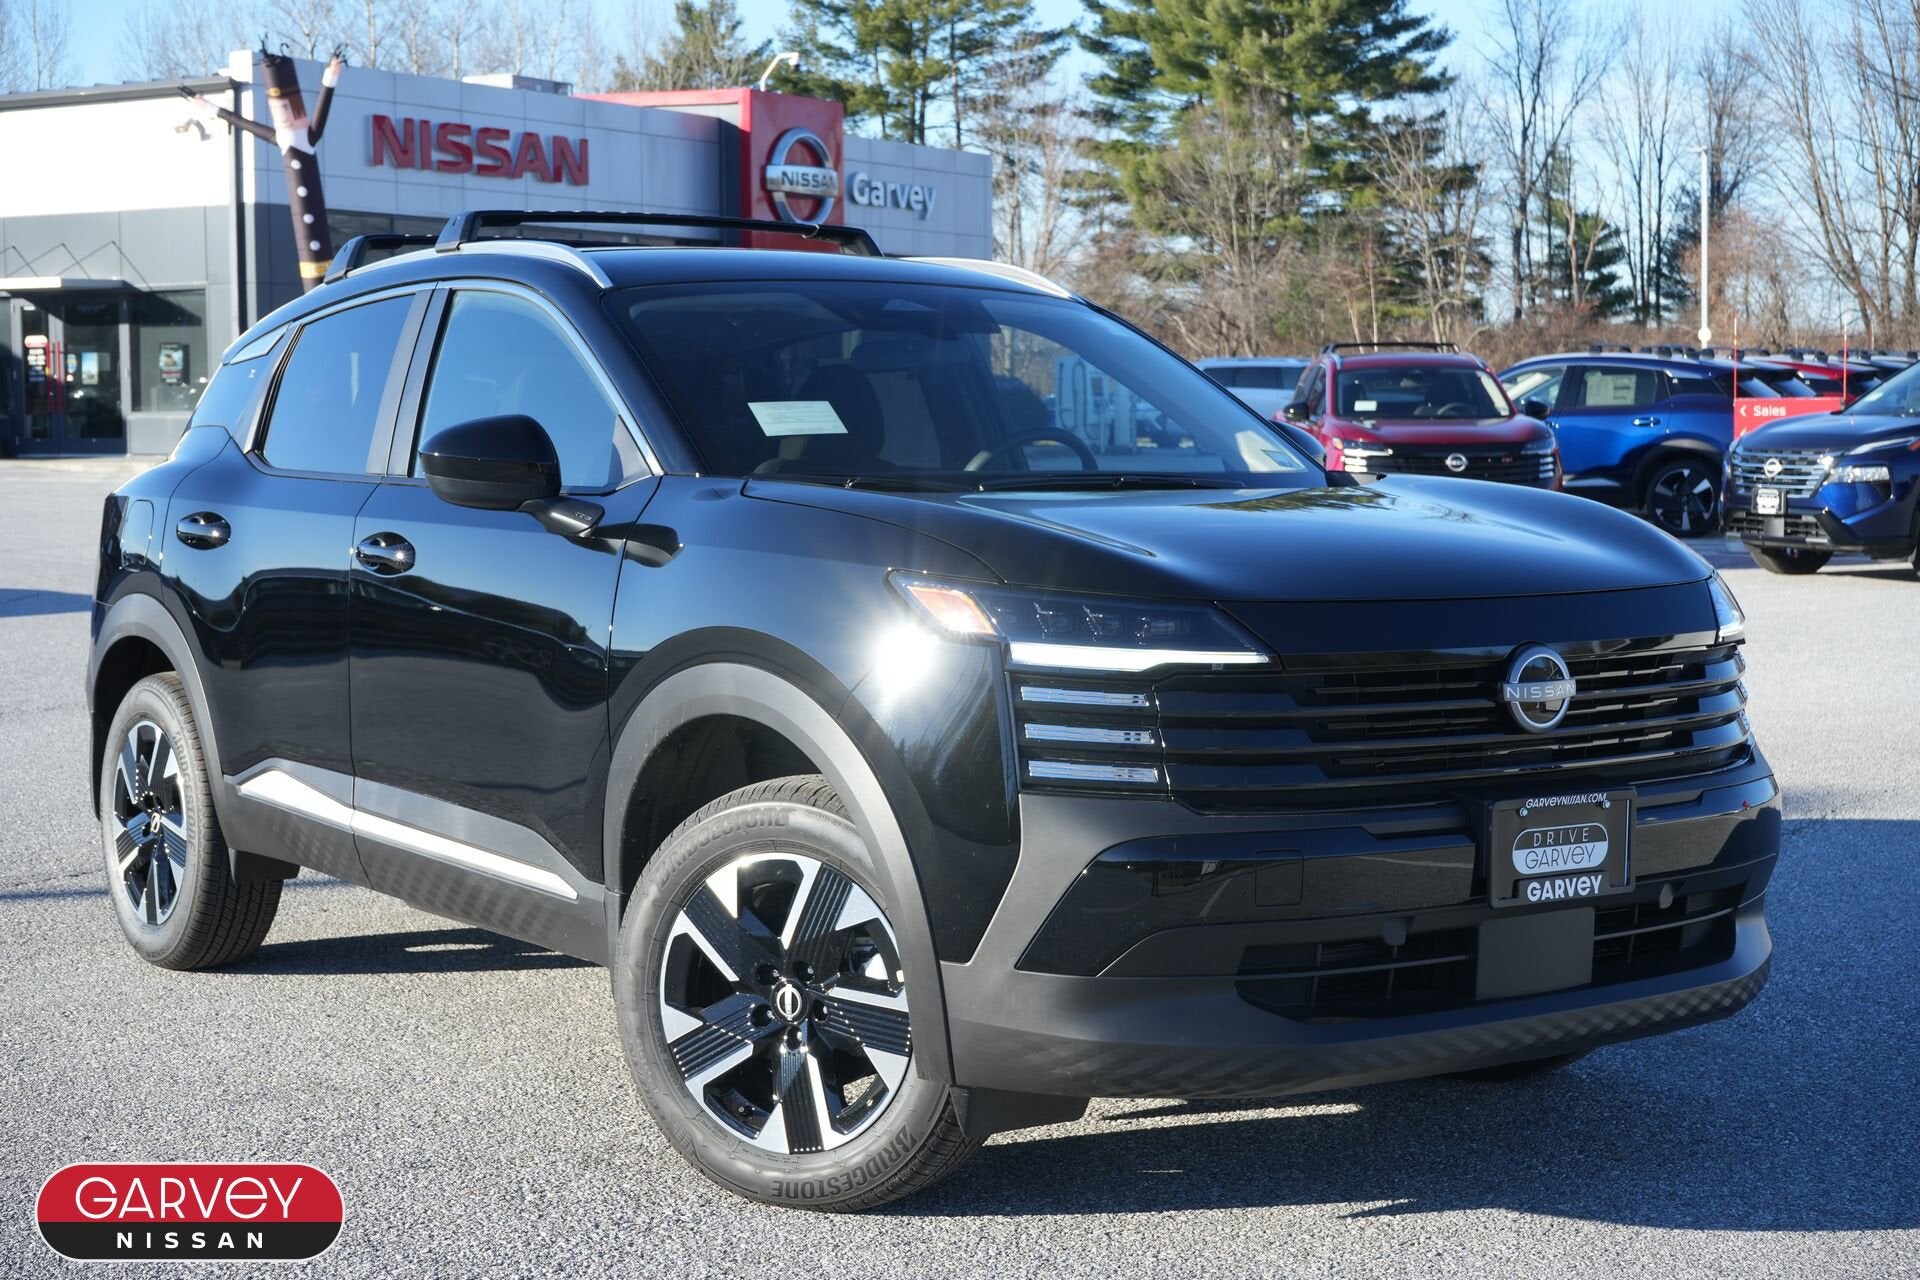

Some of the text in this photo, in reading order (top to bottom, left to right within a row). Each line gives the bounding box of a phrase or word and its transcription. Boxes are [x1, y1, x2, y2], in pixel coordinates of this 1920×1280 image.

[371, 114, 590, 187] NISSAN
[780, 170, 837, 190] NISSAN
[852, 171, 937, 221] Garvey
[1752, 404, 1788, 417] Sales
[1506, 683, 1575, 699] NISSAN
[1533, 827, 1590, 847] DRIVE
[771, 1124, 918, 1200] BRIDGESTONE
